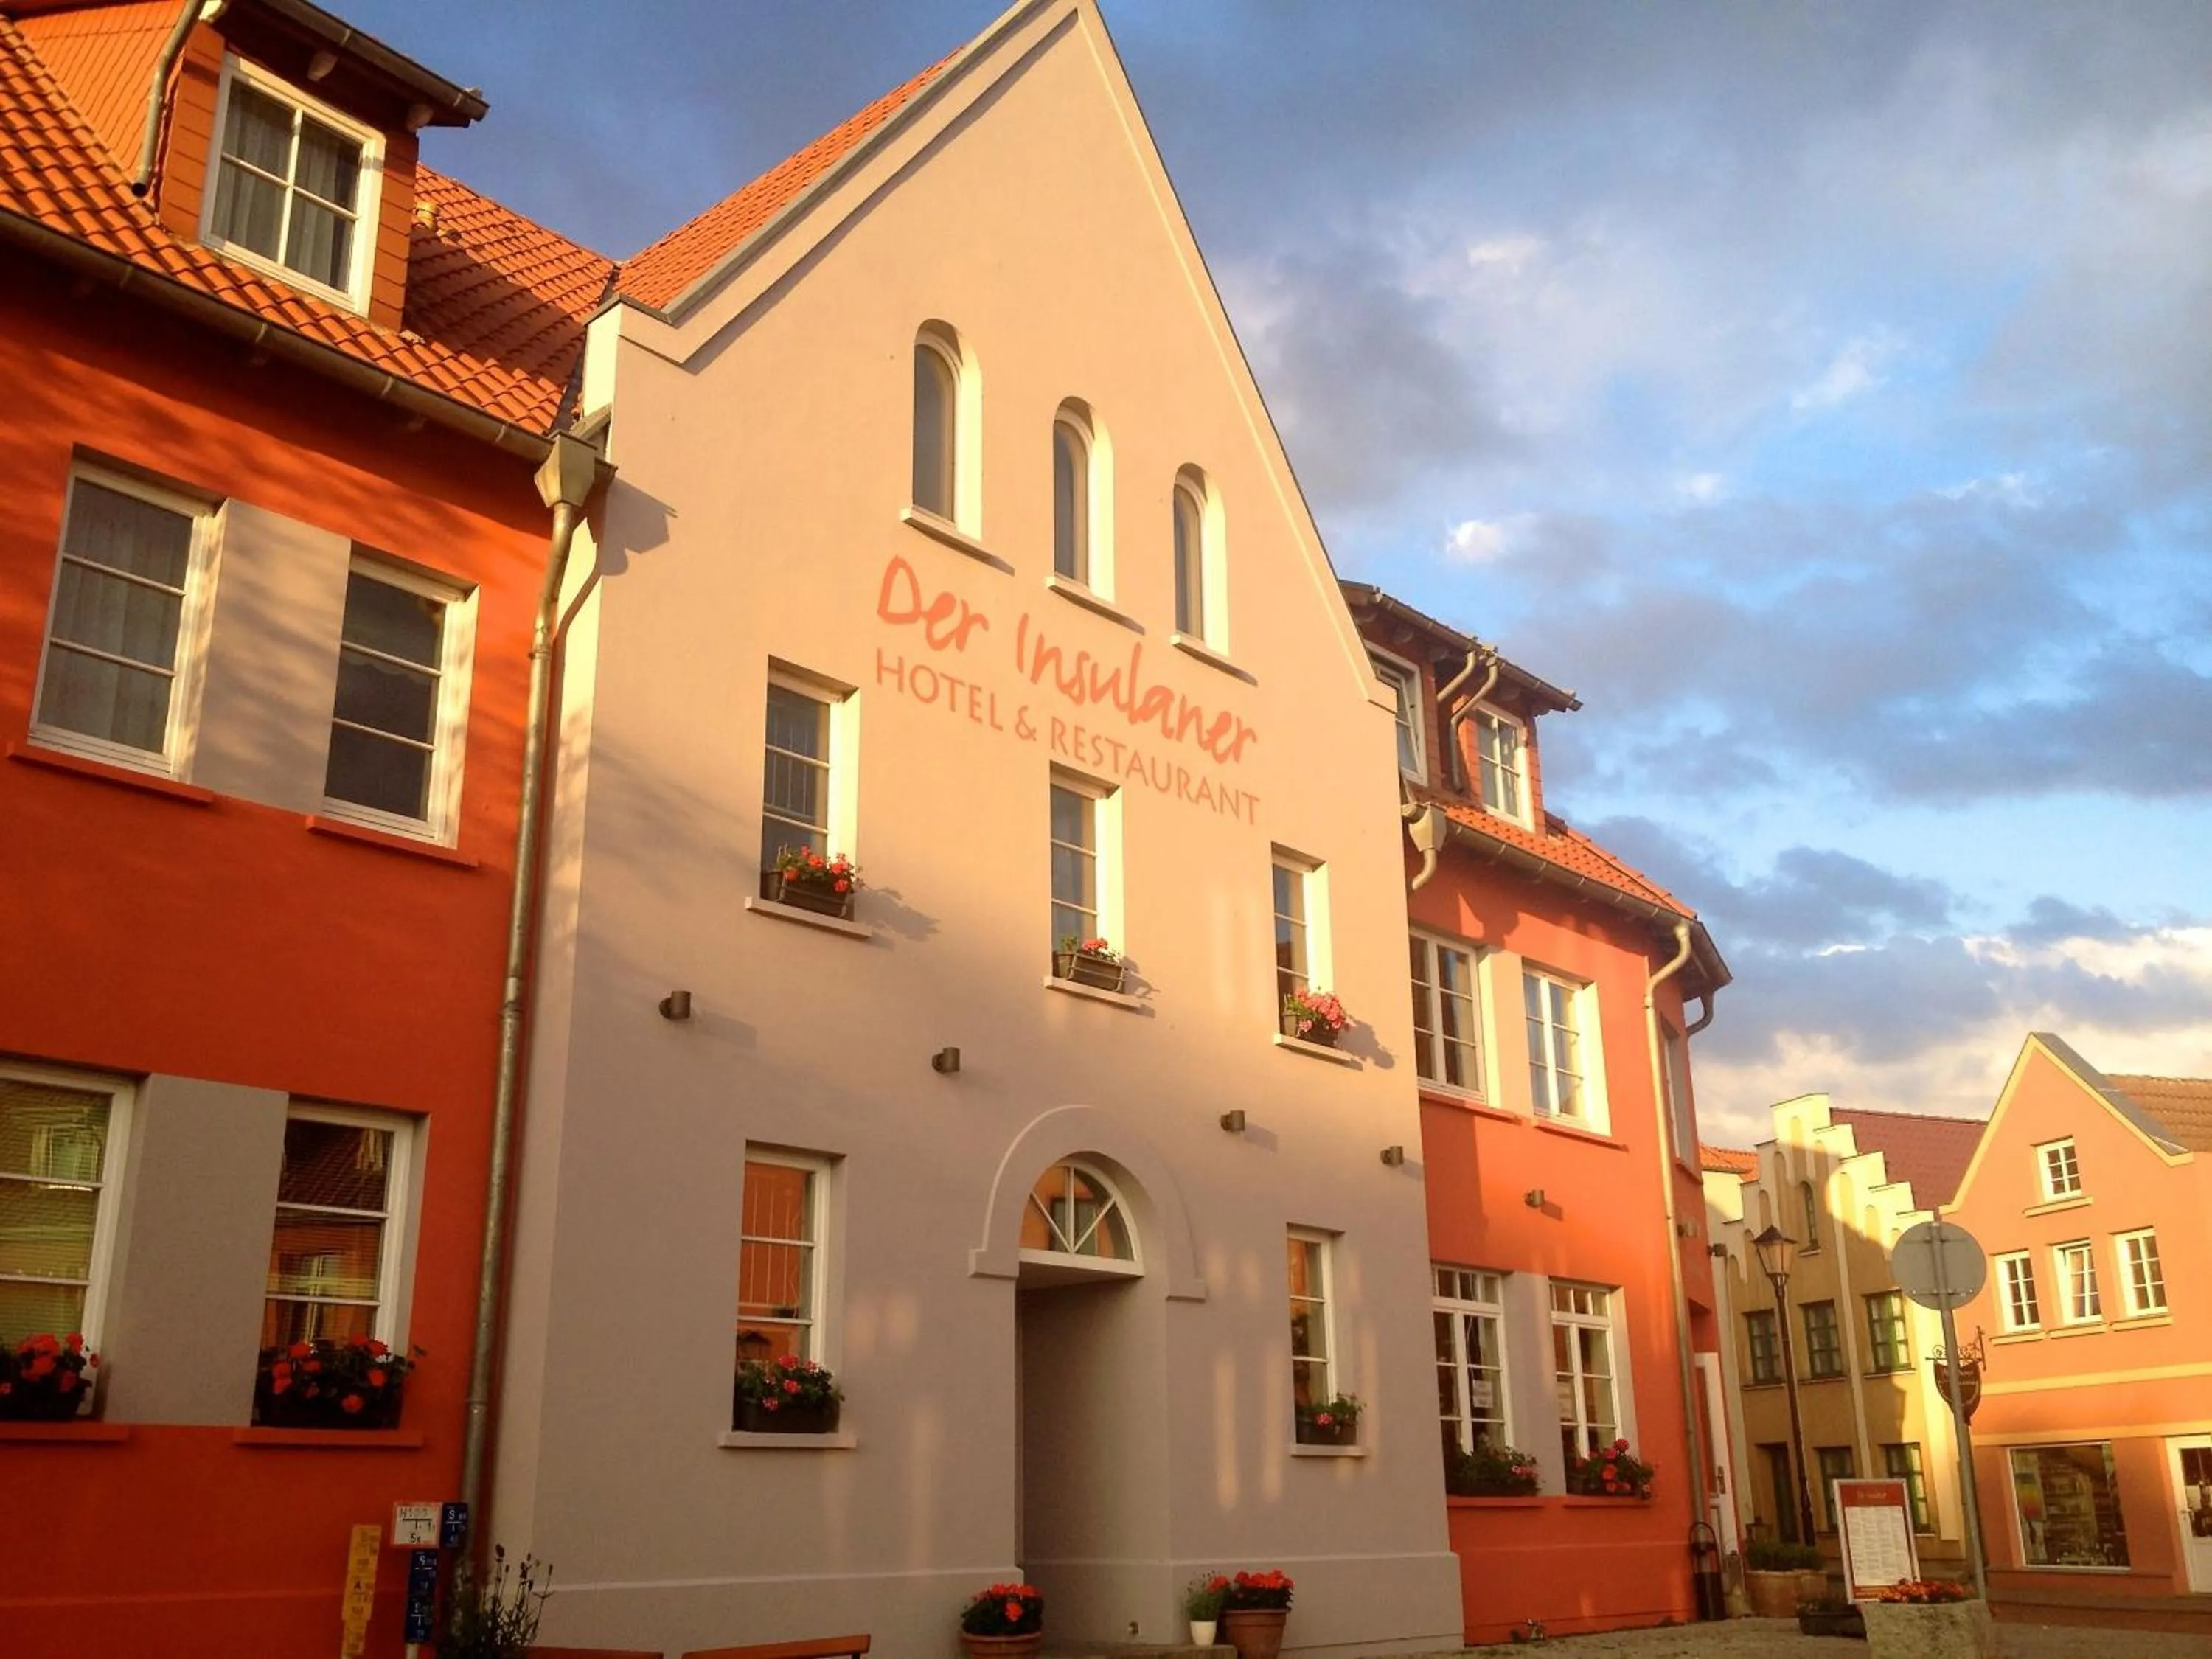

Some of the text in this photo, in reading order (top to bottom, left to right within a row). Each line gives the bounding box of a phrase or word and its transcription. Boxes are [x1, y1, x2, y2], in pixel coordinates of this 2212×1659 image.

[876, 647, 1260, 824] HOTEL & RESTAURANT
[877, 556, 1258, 764] Der Insulaner
